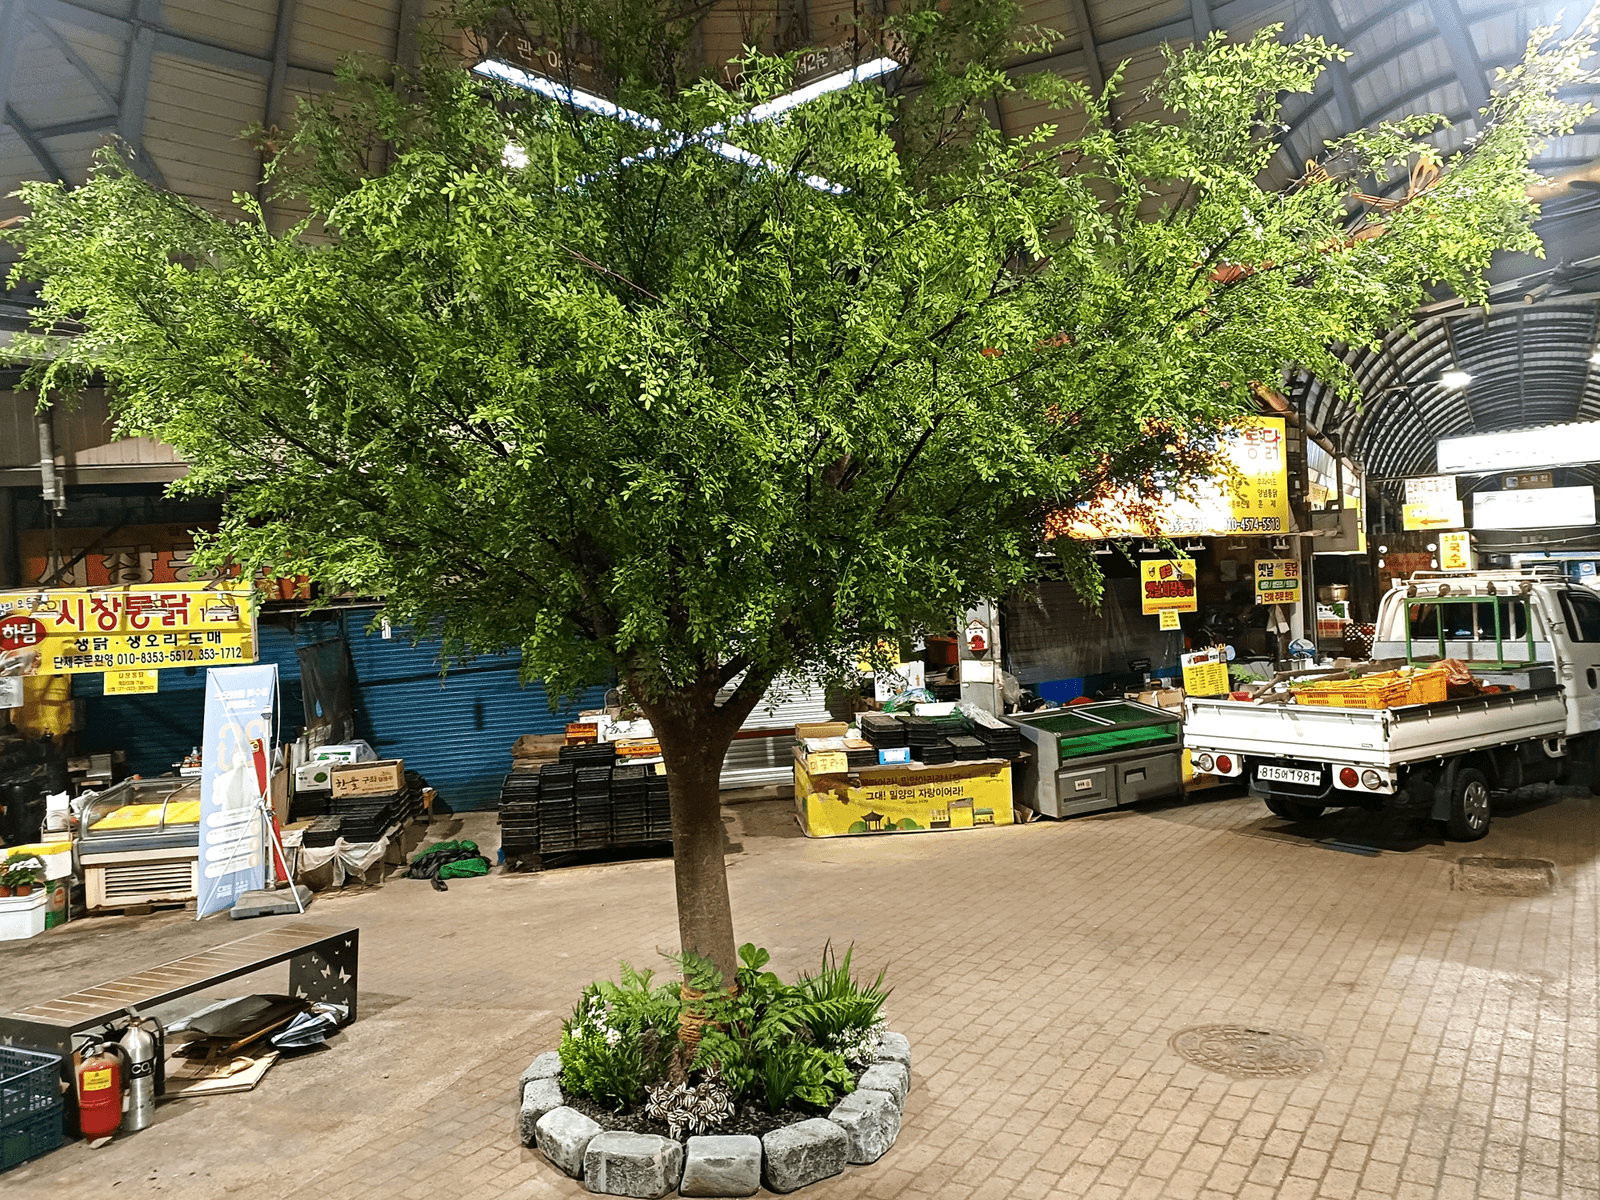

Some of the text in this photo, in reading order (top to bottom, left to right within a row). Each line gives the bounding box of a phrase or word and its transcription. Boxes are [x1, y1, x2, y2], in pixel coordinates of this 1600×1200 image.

[1258, 562, 1274, 577] 옛날
[1284, 562, 1298, 577] 통닭
[55, 594, 191, 631] 시장통닭
[2, 622, 37, 644] 하림
[75, 630, 221, 652] 생닭 생오리 도매
[54, 656, 114, 669] 단체주문환영
[199, 646, 242, 660] 353-1712
[866, 786, 964, 801] 그대! 밀양의 자랑이어라!
